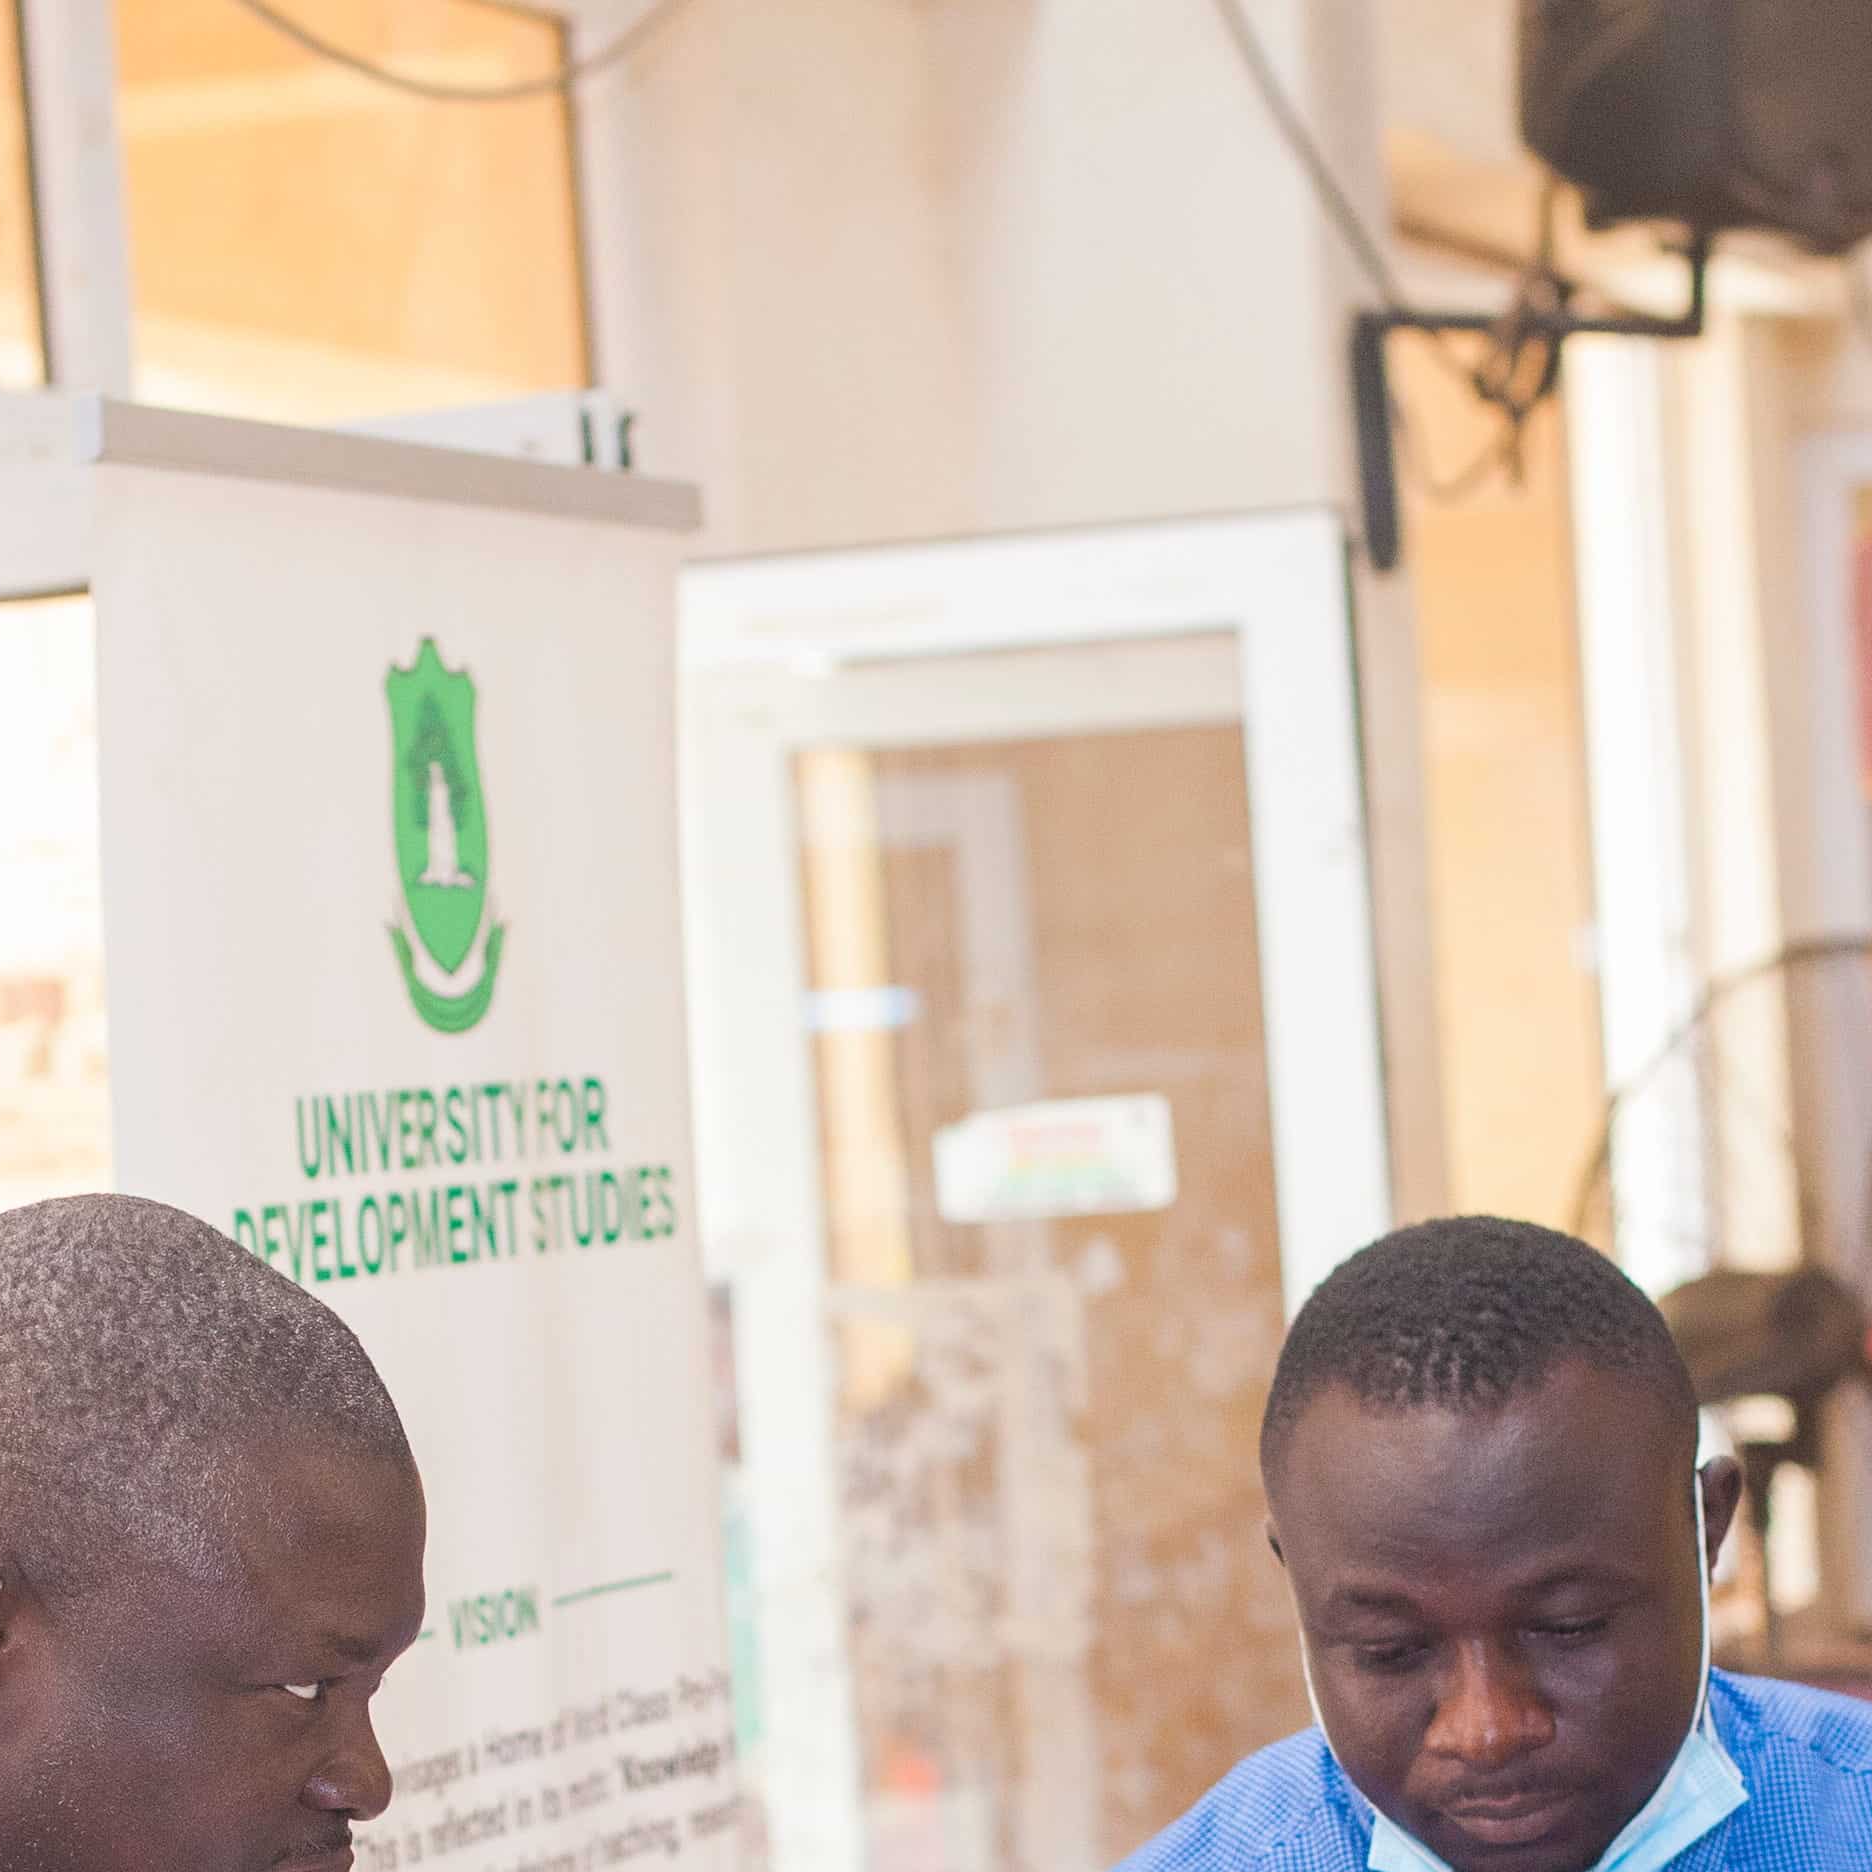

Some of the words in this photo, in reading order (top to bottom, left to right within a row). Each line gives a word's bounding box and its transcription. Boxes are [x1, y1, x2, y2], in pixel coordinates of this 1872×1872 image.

[295, 1080, 527, 1179] UNIVERSITY
[535, 1076, 610, 1155] FOR
[233, 1179, 519, 1284] DEVELOPMENT
[531, 1166, 677, 1254] STUDIES
[448, 1584, 540, 1650] VISION
